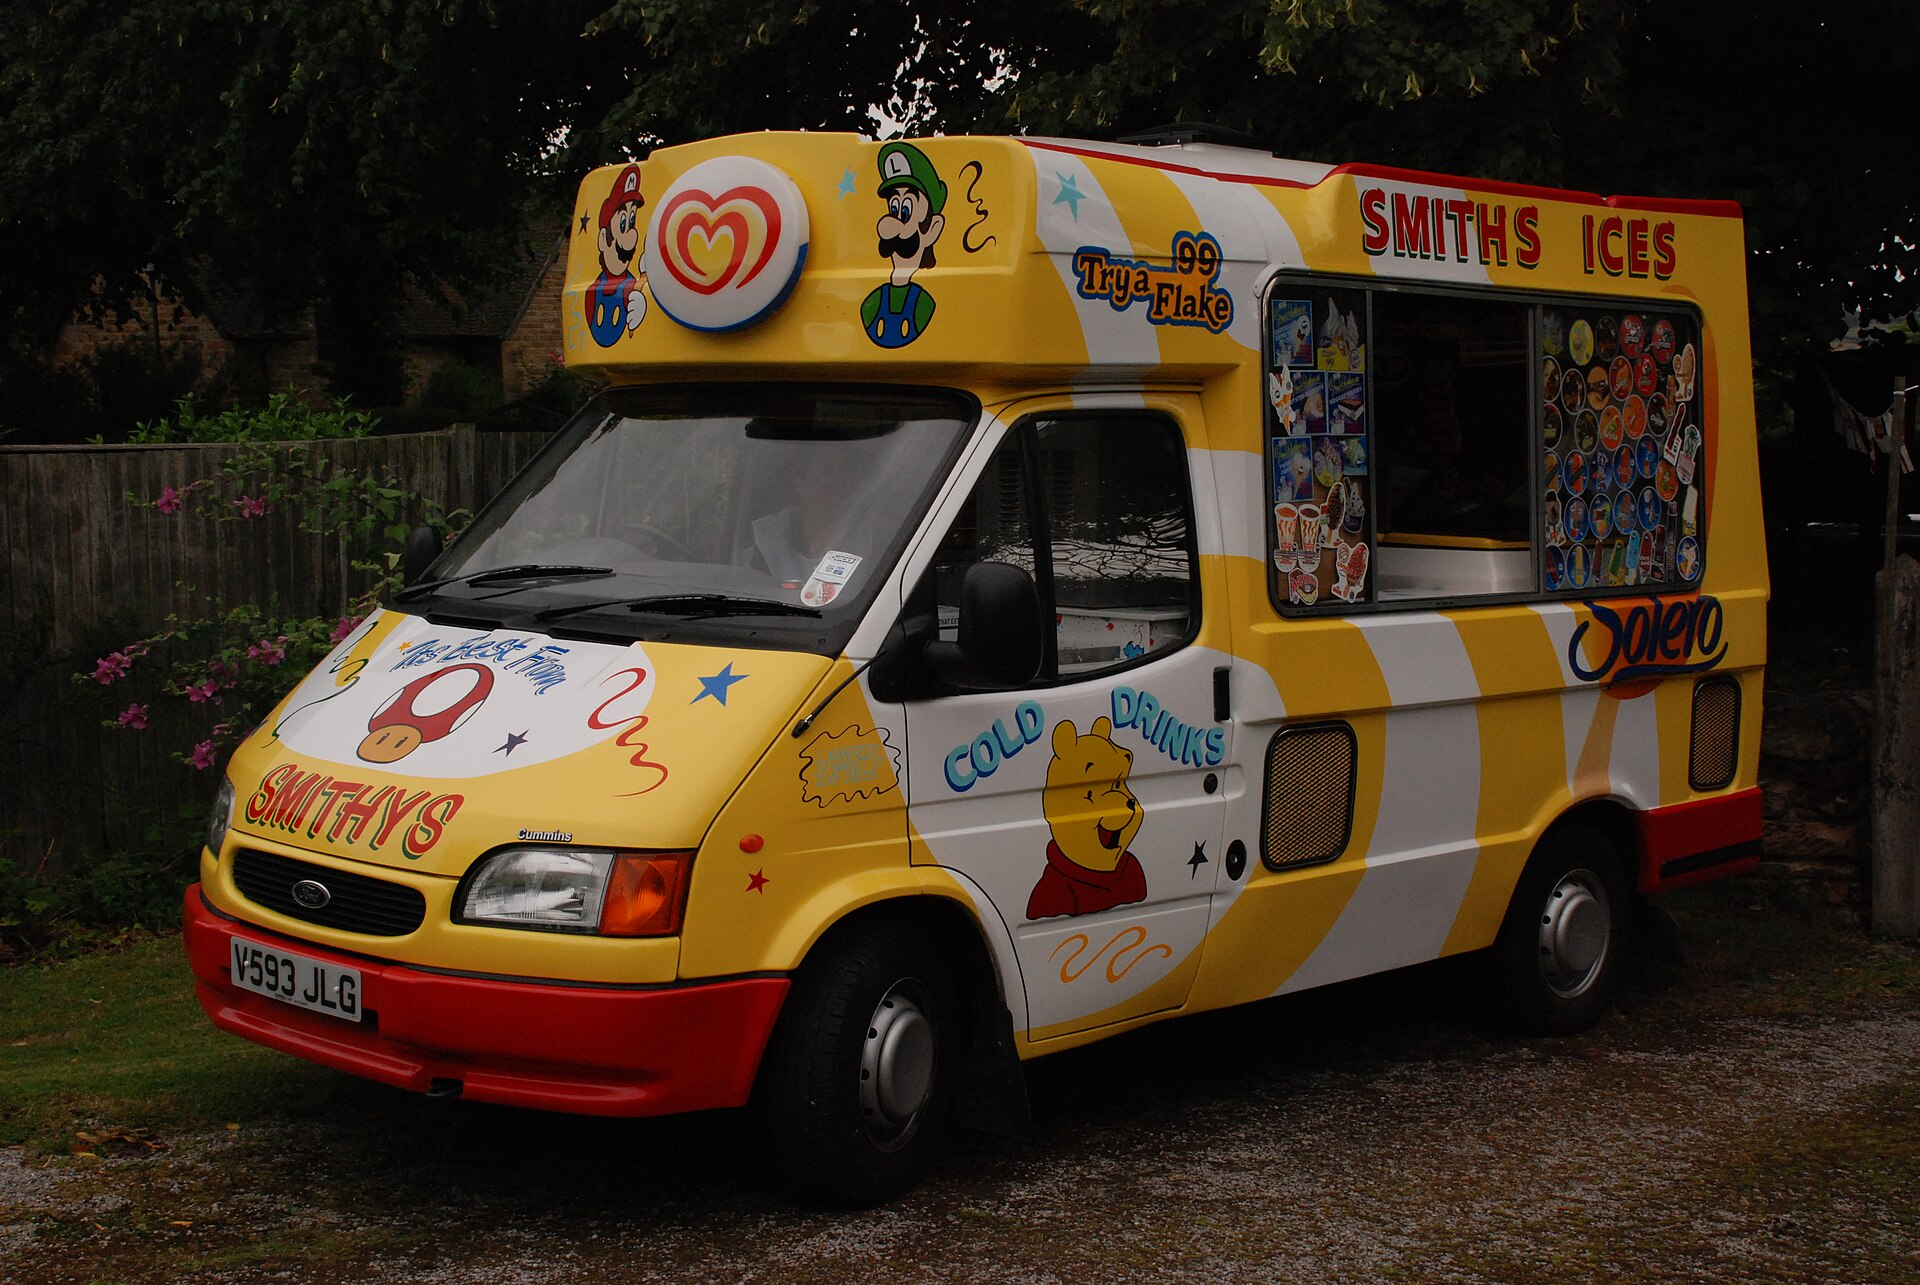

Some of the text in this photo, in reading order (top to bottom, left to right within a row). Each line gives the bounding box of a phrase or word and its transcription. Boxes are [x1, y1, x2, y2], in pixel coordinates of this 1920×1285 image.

[627, 177, 635, 189] M
[890, 158, 901, 174] L
[1360, 187, 1678, 281] SMITHS ICES
[1079, 256, 1150, 303] Try a
[1178, 241, 1217, 276] 99
[1153, 283, 1228, 327] Flake
[503, 645, 571, 696] From
[944, 686, 1226, 792] COLD DRINKS
[245, 763, 464, 860] SMITHYS
[517, 828, 573, 842] Cummins
[235, 943, 356, 1015] V593 JLG
